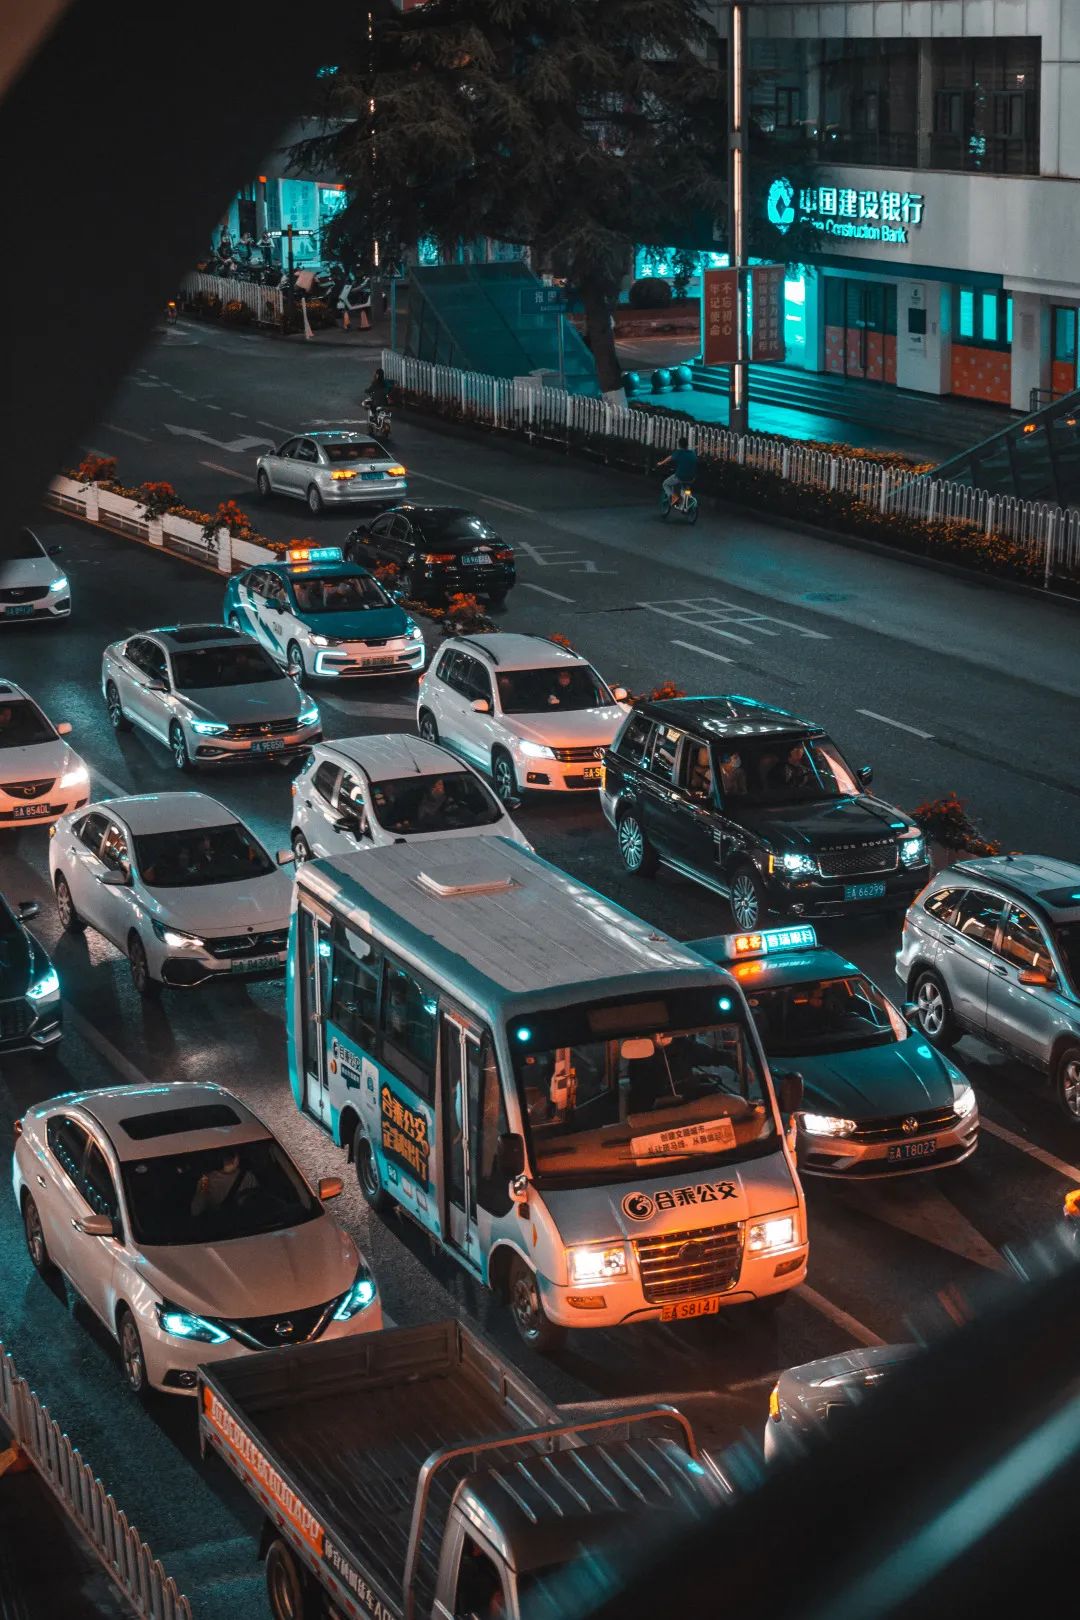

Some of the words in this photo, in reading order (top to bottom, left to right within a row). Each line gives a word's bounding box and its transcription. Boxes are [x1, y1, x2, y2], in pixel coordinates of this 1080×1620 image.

[800, 187, 923, 224] 中国建设银行
[826, 219, 880, 240] Construction
[881, 225, 907, 243] Bank
[710, 283, 720, 336] 牢记使命
[721, 282, 732, 335] 不忘初心
[862, 839, 894, 847] ROVER
[381, 1086, 426, 1143] 合乘公交
[655, 1182, 739, 1211] 合乘公交
